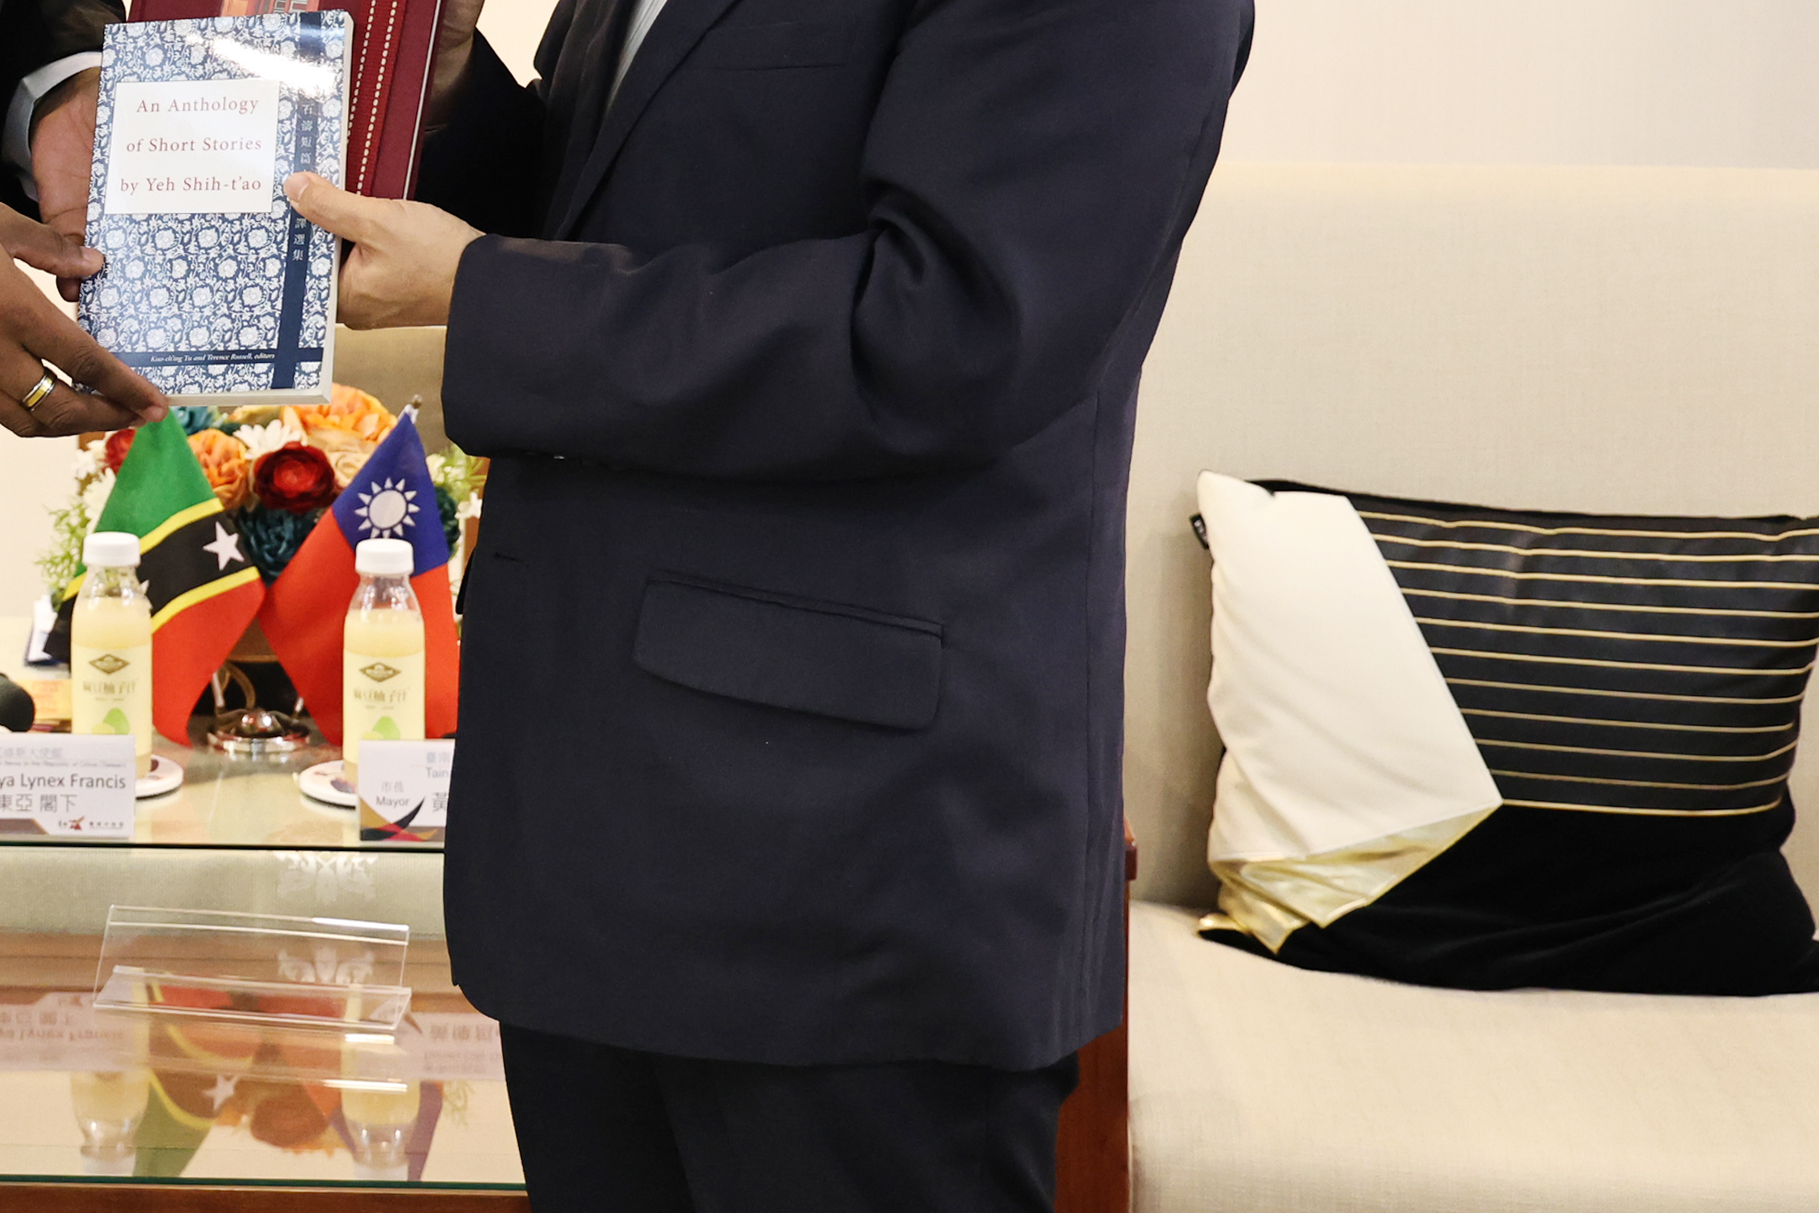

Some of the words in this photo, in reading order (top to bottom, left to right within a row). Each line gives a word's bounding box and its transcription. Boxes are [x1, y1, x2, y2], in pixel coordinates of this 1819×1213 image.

[136, 99, 160, 113] An
[167, 96, 259, 115] Anthology
[126, 138, 144, 153] of
[148, 137, 195, 152] Short
[202, 137, 262, 151] Stories
[120, 178, 139, 196] by
[146, 177, 175, 191] Yeh
[182, 176, 262, 191] Shih-t'ao
[254, 353, 275, 361] editors
[20, 773, 65, 789] Lynex
[70, 773, 126, 789] Francis
[375, 795, 410, 808] Mayor
